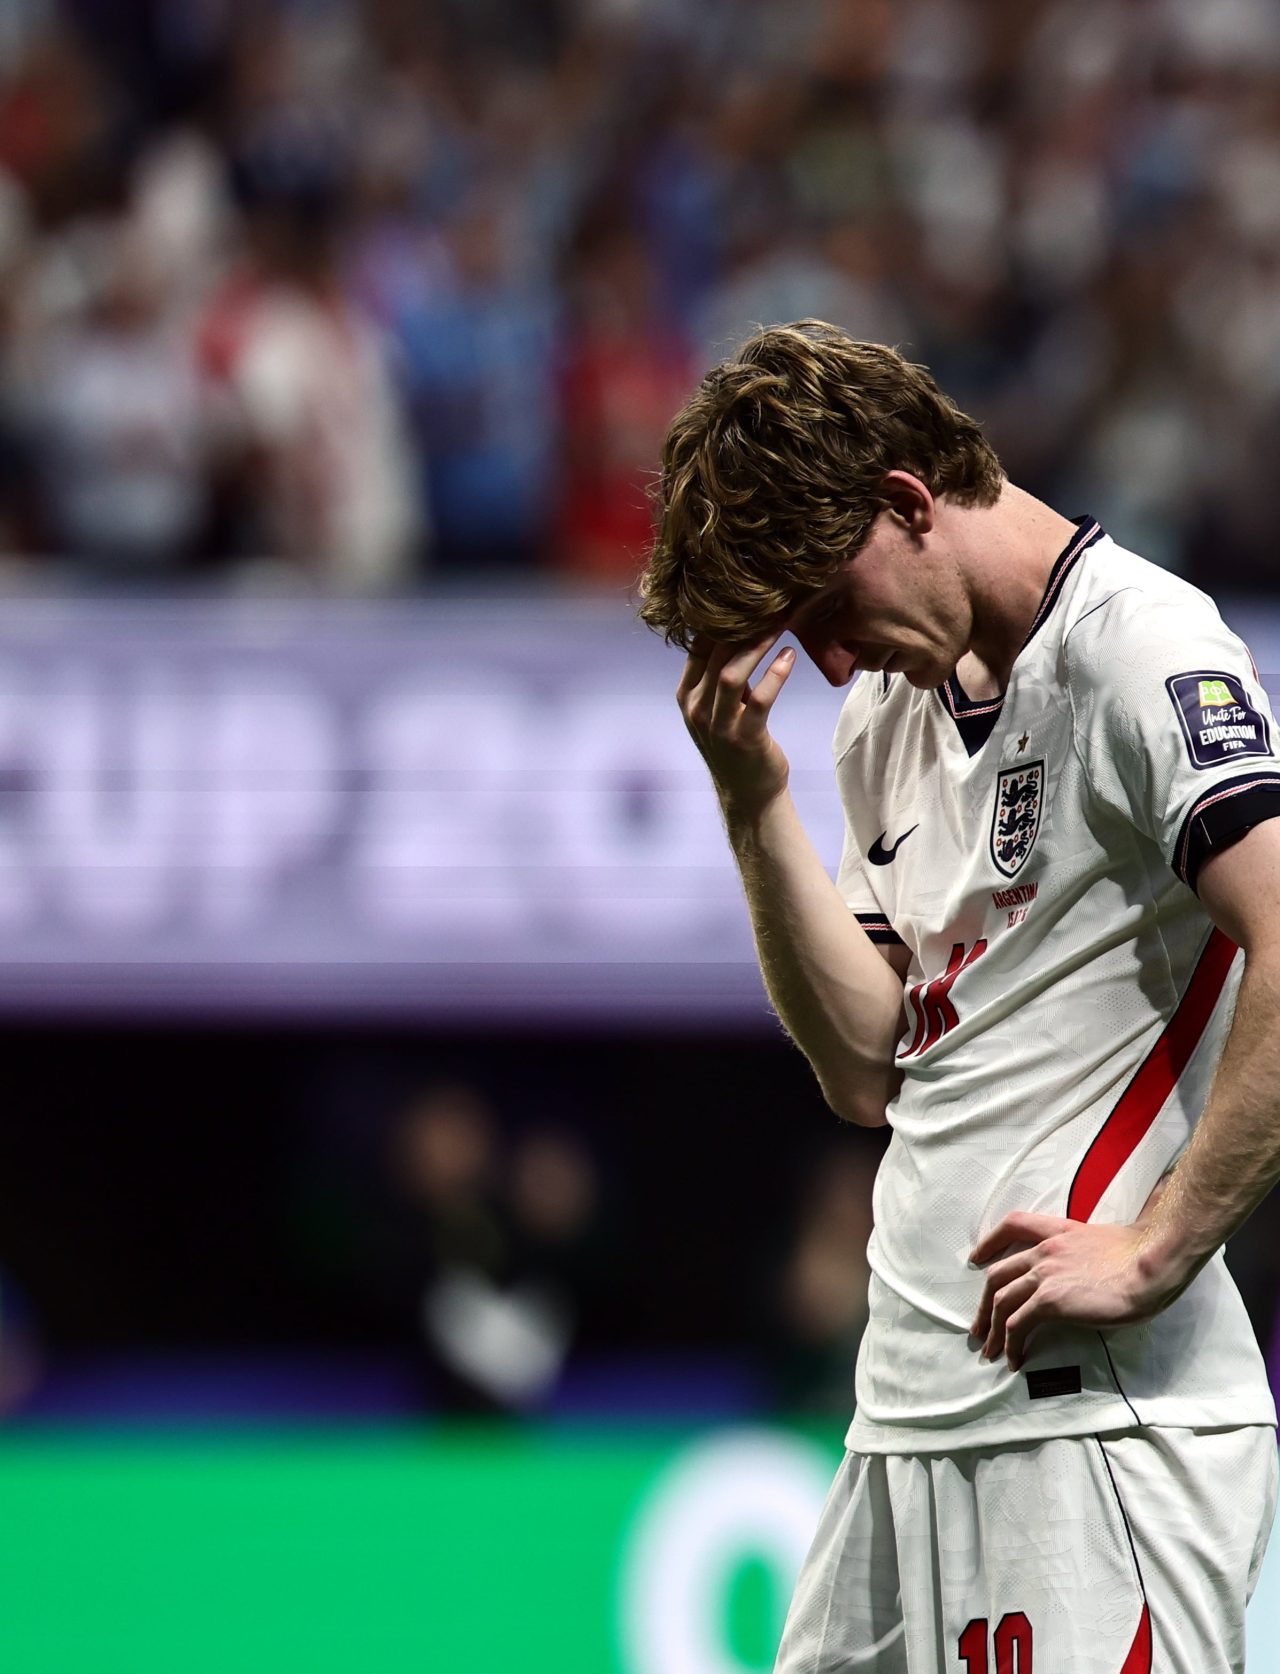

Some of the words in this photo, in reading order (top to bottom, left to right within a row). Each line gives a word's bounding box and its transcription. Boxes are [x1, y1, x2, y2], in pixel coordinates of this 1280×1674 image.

[1202, 708, 1231, 726] Unite
[1230, 706, 1246, 723] For
[1199, 725, 1257, 746] EDUCATION
[1222, 740, 1246, 752] FIFA
[0, 660, 338, 930] UP
